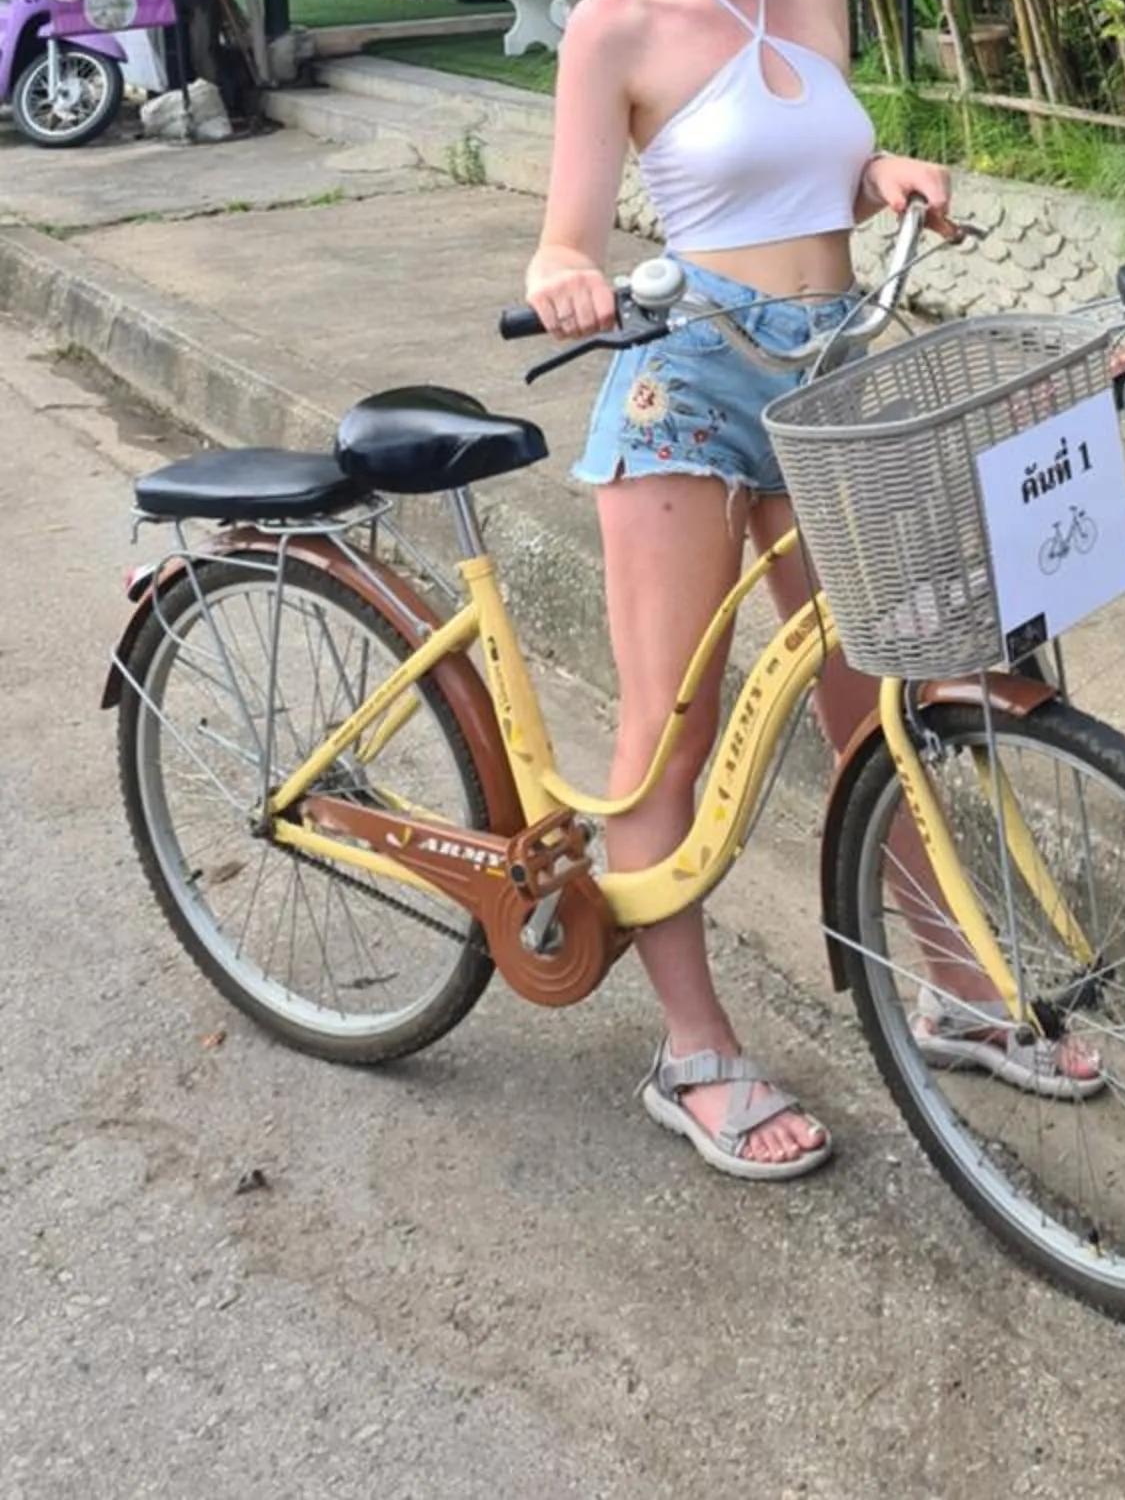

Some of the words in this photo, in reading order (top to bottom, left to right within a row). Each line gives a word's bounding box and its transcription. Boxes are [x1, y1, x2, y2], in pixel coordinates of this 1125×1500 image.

[1020, 437, 1073, 504] คันที่
[1077, 441, 1093, 472] 1
